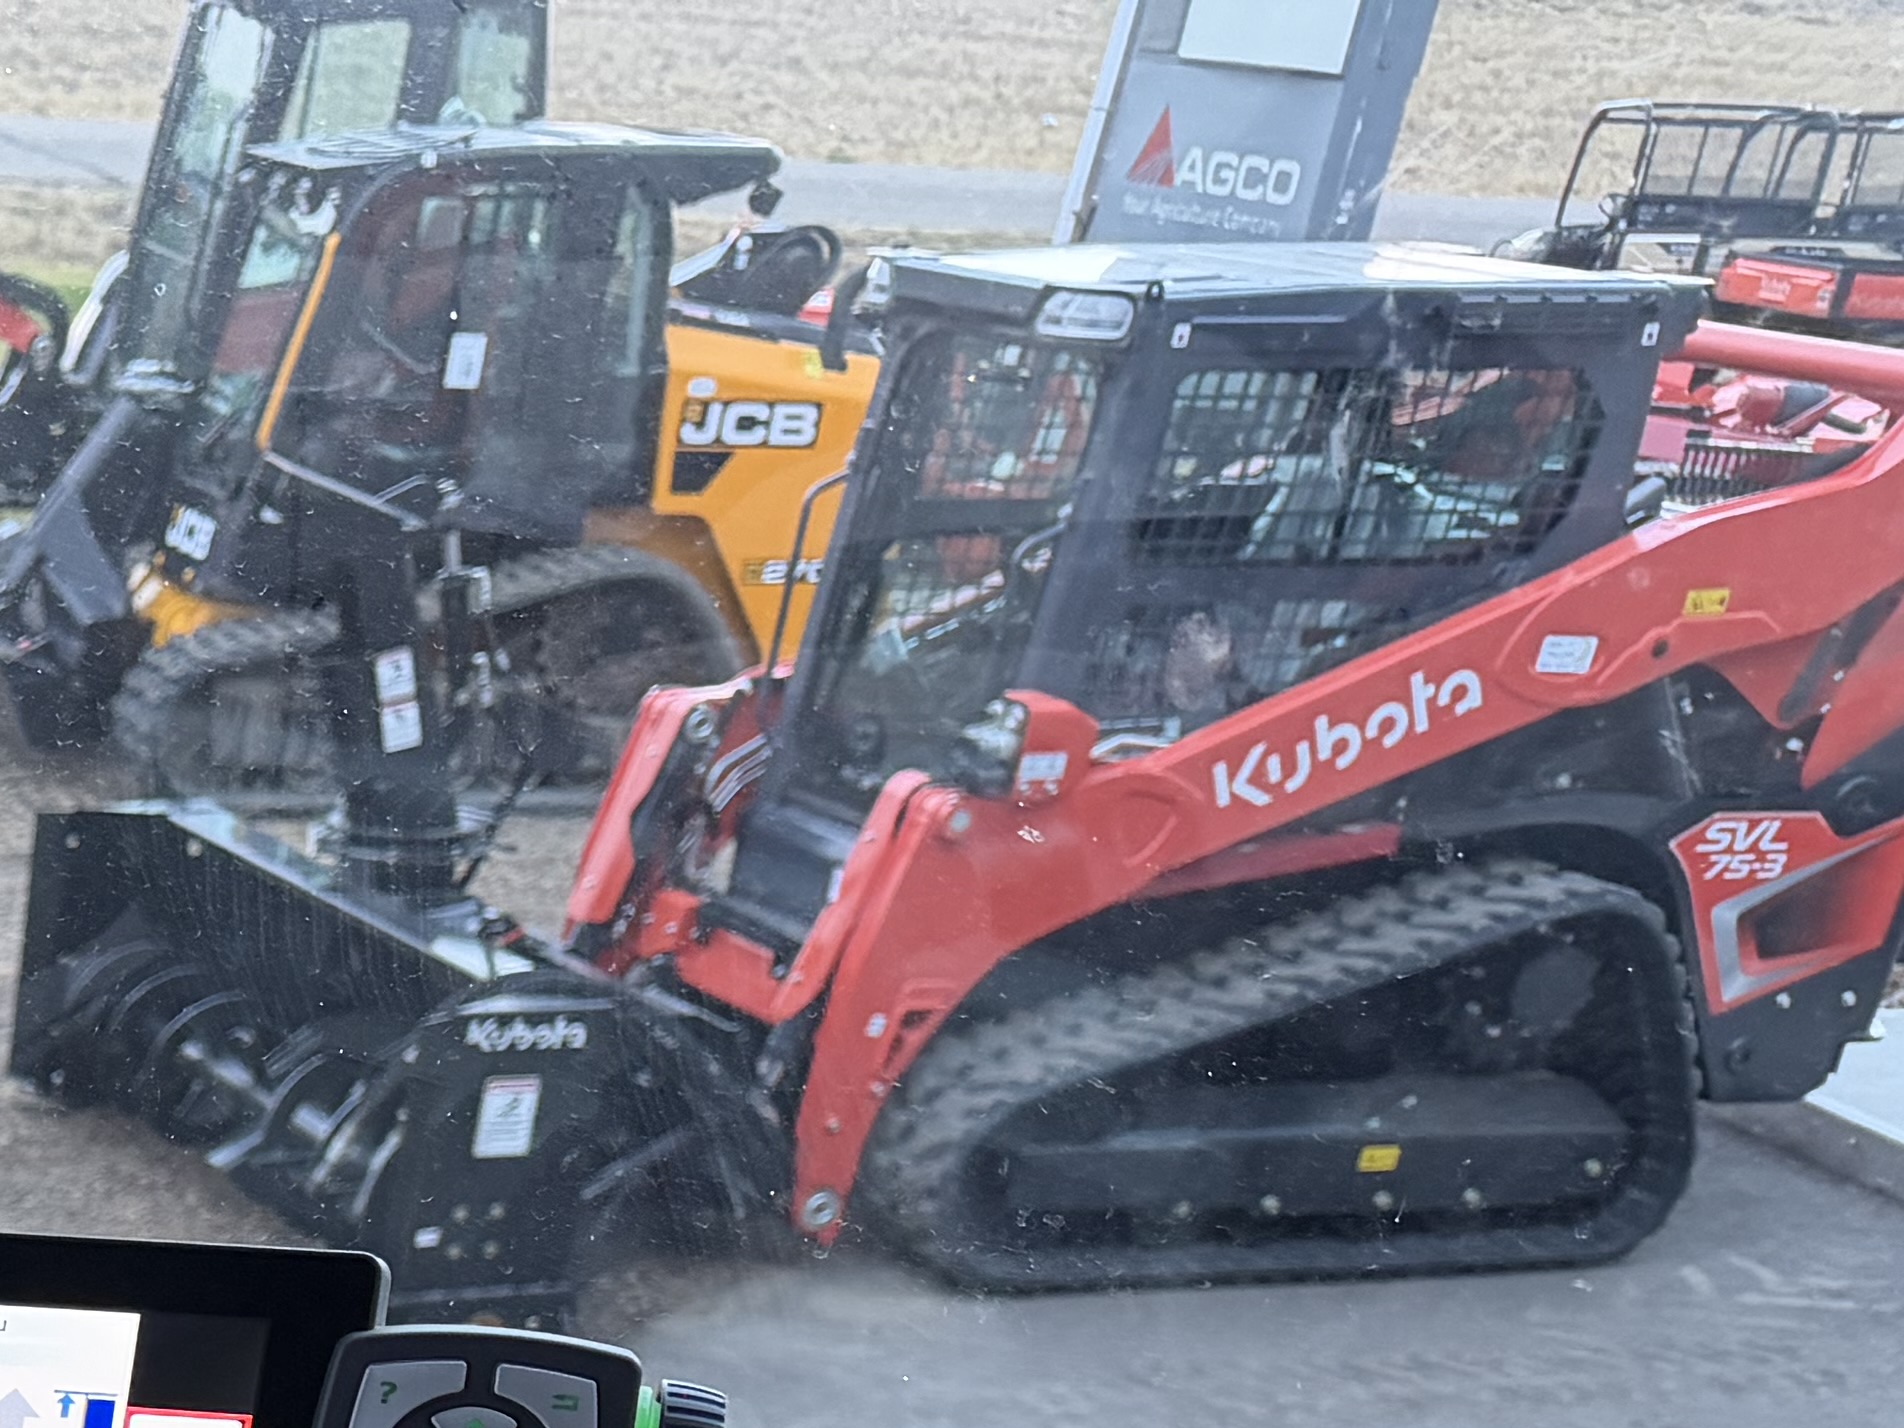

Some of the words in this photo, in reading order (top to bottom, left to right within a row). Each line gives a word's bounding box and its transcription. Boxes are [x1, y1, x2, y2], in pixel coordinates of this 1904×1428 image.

[1176, 146, 1301, 205] AGCO
[679, 401, 820, 448] JCB
[1212, 668, 1483, 808] Kubota
[1695, 820, 1789, 852] SVL
[464, 1014, 588, 1051] Kubota
